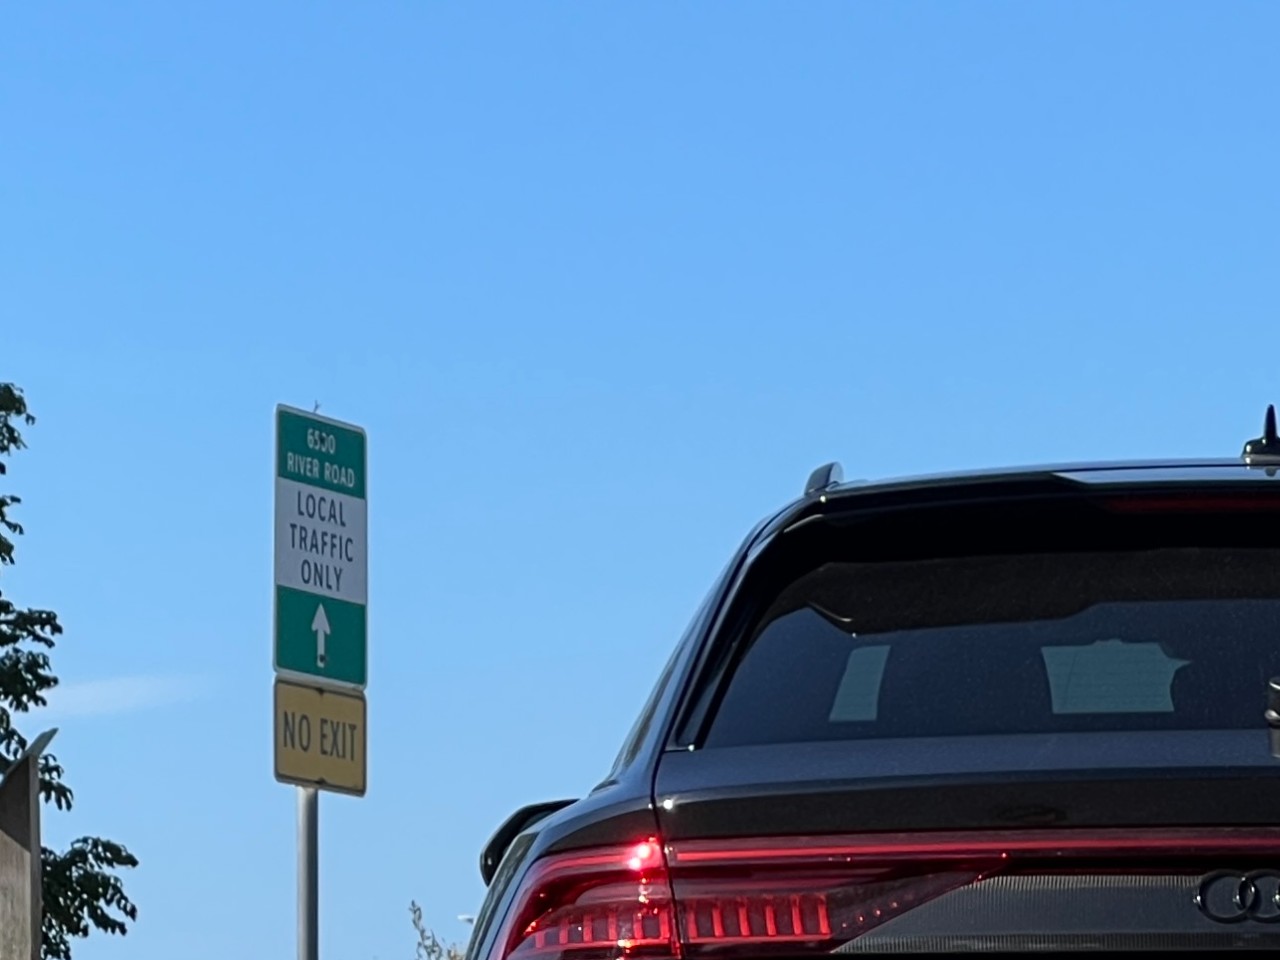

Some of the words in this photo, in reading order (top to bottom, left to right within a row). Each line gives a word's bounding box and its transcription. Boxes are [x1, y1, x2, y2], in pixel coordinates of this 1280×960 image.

[287, 452, 319, 479] RIVER
[324, 462, 355, 487] ROAD
[297, 491, 346, 527] LOCAL
[290, 524, 353, 562] TRAFFIC
[301, 559, 343, 591] ONLY
[283, 710, 311, 752] NO
[320, 718, 357, 761] EXIT
